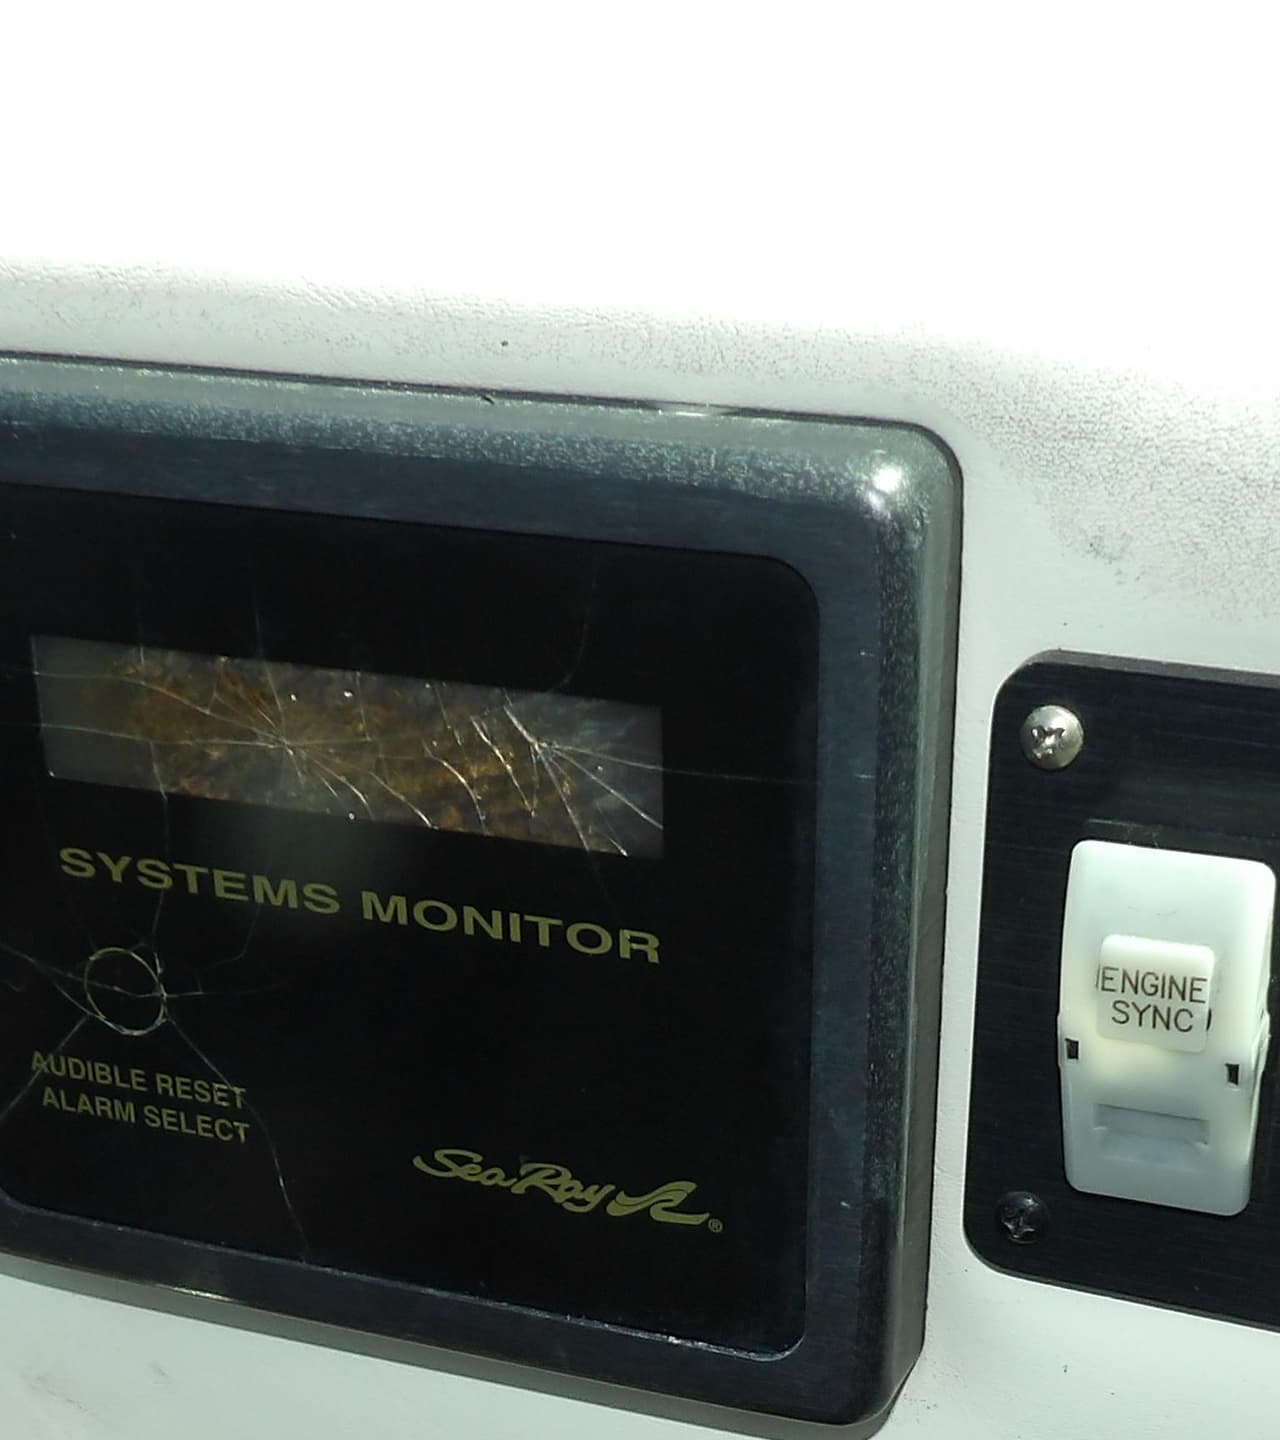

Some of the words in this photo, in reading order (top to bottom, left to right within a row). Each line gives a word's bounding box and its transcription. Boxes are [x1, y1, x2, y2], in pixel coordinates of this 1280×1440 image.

[58, 847, 341, 915] SYSTEMS
[361, 890, 662, 964] MONITOR
[1101, 966, 1208, 1004] ENGINE
[1111, 999, 1194, 1033] SYNC
[31, 1050, 149, 1092] AUDIBLE
[155, 1072, 247, 1109] RESET
[42, 1087, 136, 1124] ALARM
[143, 1105, 250, 1144] SELECT
[413, 1149, 517, 1187] Sea
[511, 1162, 616, 1213] Ray
